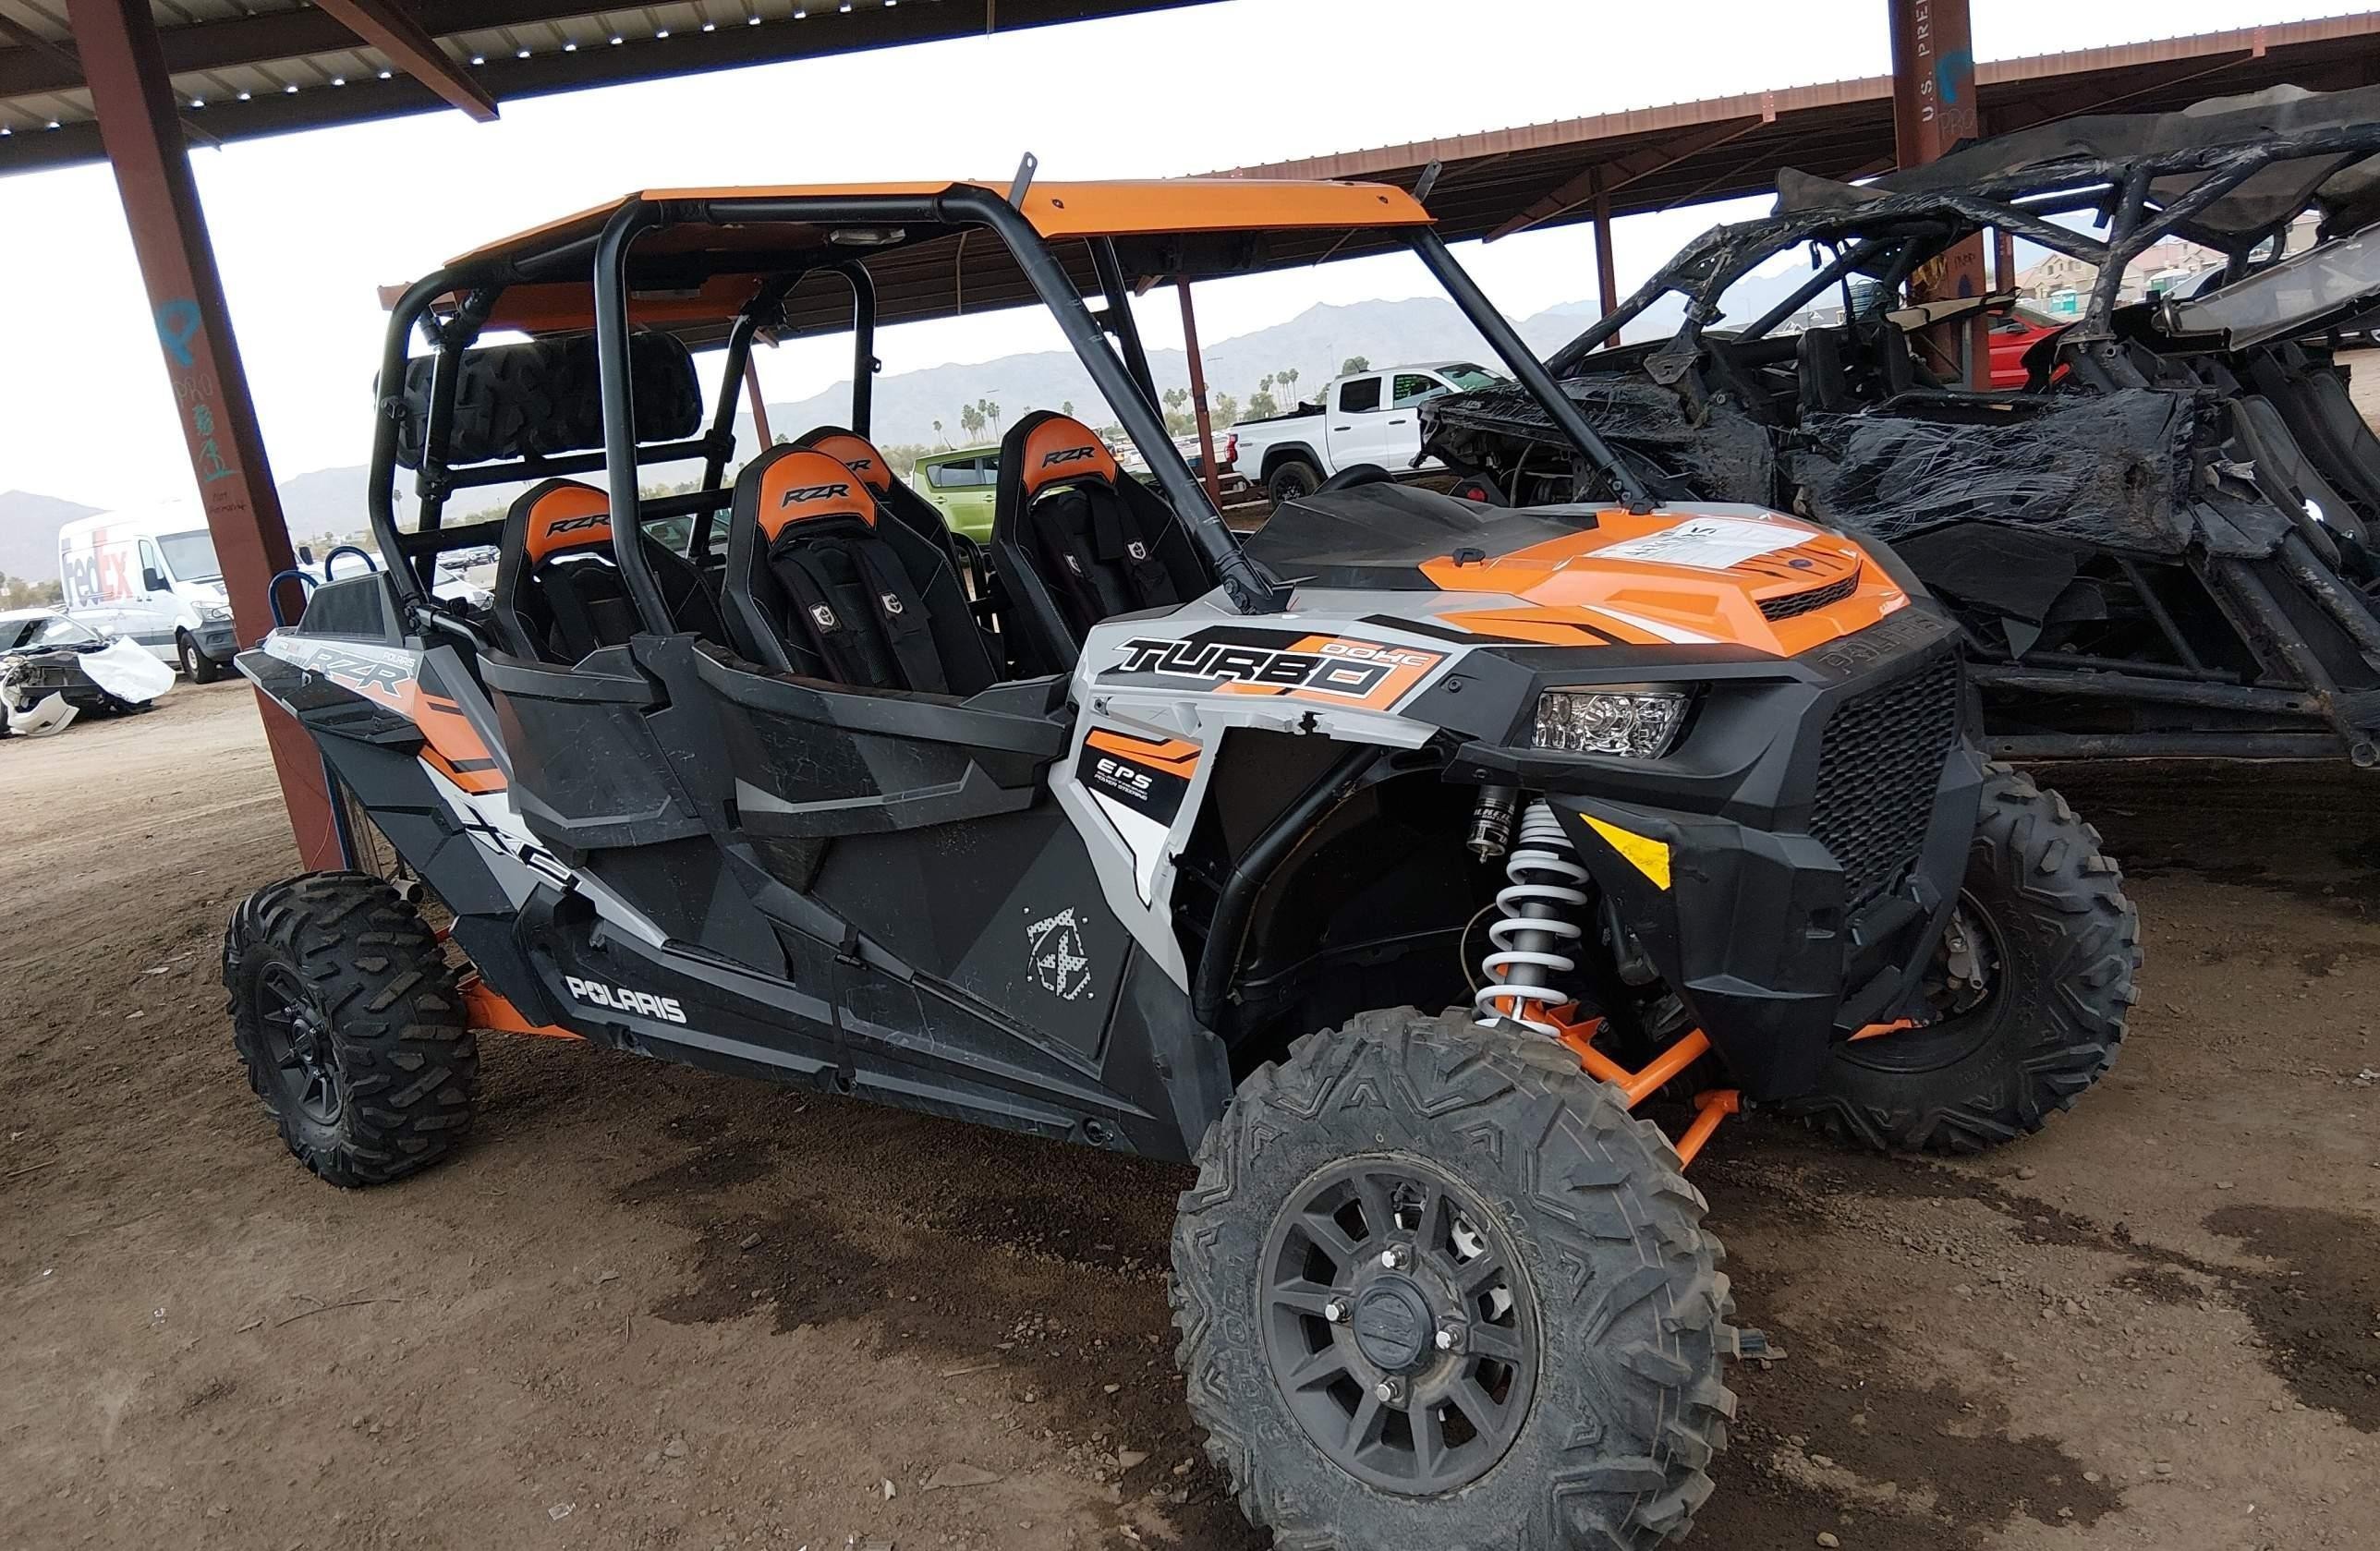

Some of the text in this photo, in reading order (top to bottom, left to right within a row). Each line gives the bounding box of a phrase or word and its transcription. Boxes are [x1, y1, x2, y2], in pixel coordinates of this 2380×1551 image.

[1915, 0, 1935, 122] U.S. PRE
[1041, 445, 1096, 469] RZR
[781, 482, 852, 509] RZR
[61, 529, 133, 608] FedEx
[382, 650, 416, 668] POLARIS
[1112, 636, 1398, 699] TURBO
[1319, 642, 1433, 667] DOHC
[1817, 614, 1944, 675] POLARIS
[303, 646, 412, 698] RZR
[1096, 757, 1153, 790] EPS
[565, 975, 687, 1024] POLARIS
